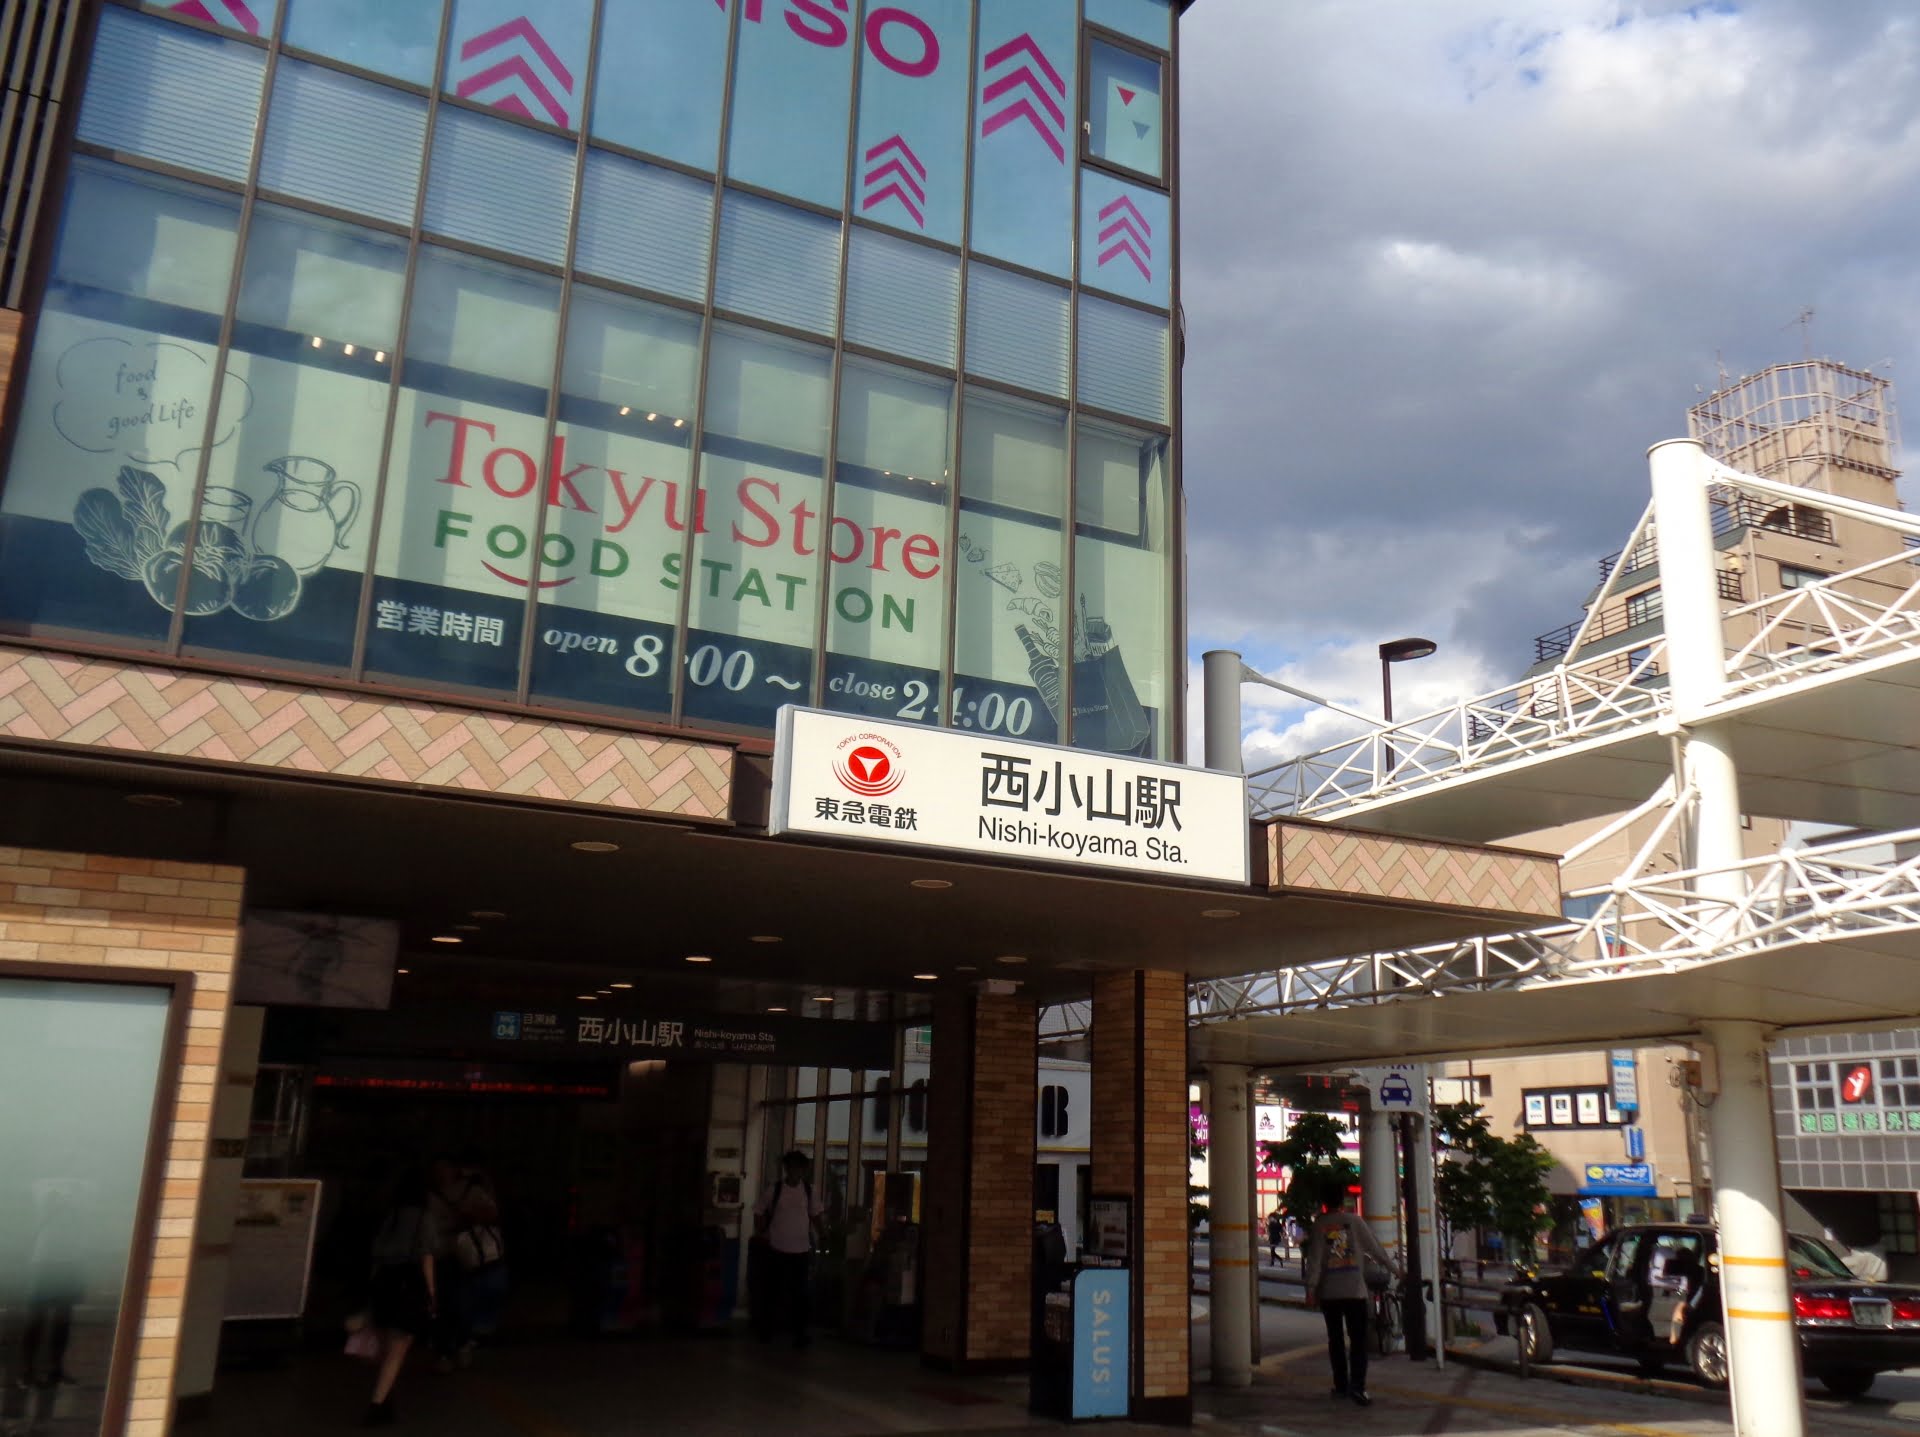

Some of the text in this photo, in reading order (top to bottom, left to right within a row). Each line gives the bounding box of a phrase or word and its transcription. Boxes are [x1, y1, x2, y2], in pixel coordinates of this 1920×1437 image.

[116, 360, 158, 394] food
[106, 398, 195, 439] good Life
[425, 410, 941, 580] Tokyu Store
[434, 508, 915, 633] FOOD STATON
[376, 600, 505, 647] 営業時間
[542, 628, 618, 656] open
[625, 634, 755, 692] 800
[829, 672, 897, 702] close
[836, 733, 902, 759] TOKYU CORPORATION
[980, 752, 1182, 832] 西小山駅
[814, 797, 918, 832] 東急電鉄
[978, 815, 1188, 864] Nishi-koyama Sta.
[497, 1024, 516, 1036] 04
[577, 1016, 684, 1048] 西小山駅
